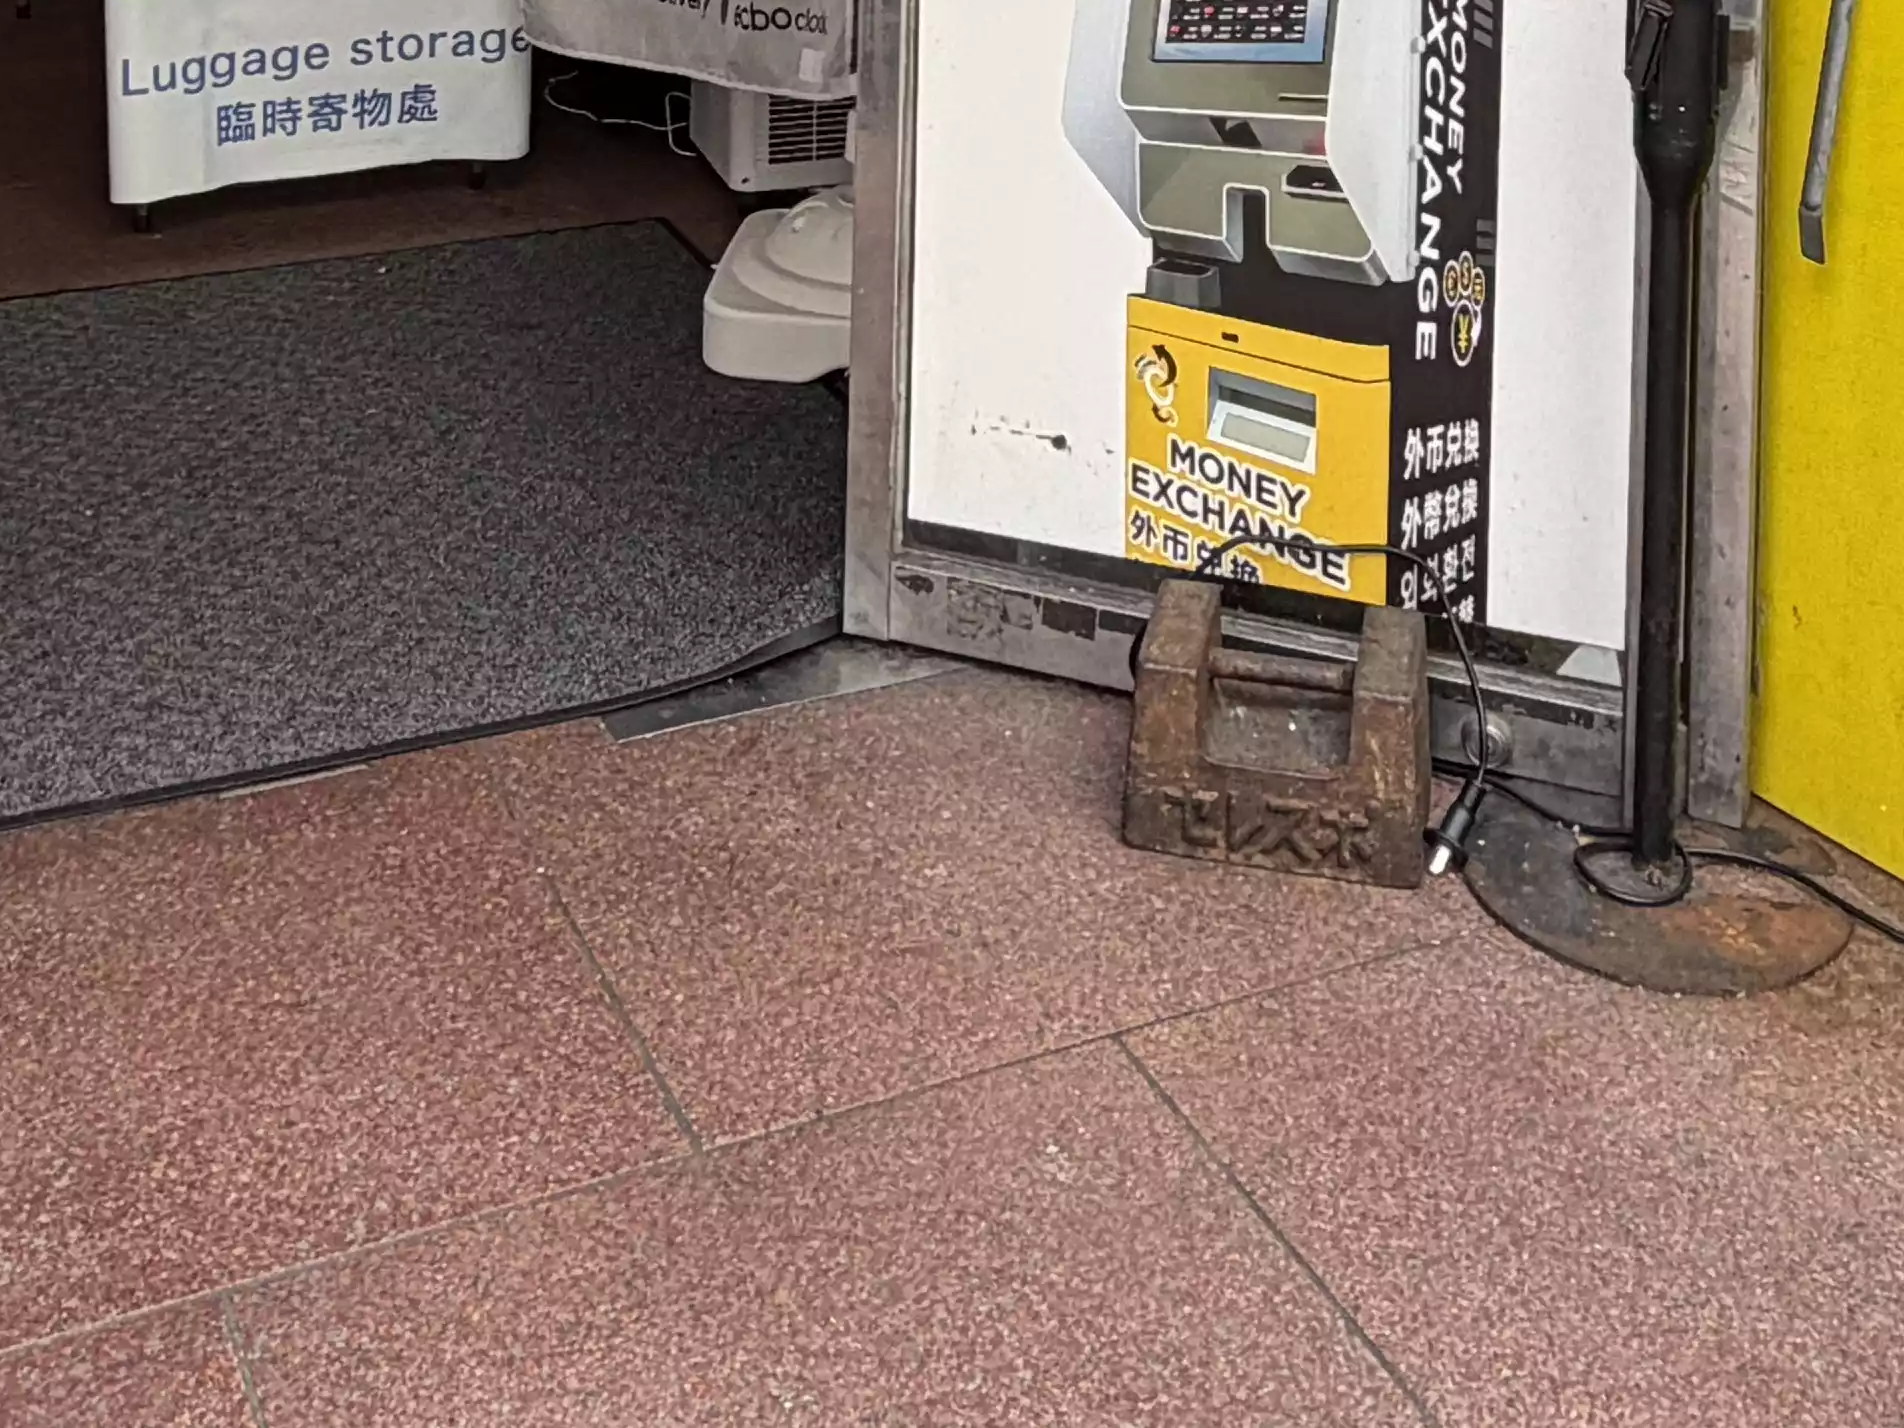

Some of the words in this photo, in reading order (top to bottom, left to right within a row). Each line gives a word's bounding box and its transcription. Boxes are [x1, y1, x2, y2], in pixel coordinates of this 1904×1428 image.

[121, 43, 331, 97] Luggage
[349, 25, 531, 68] storage
[215, 83, 439, 147] 臨時寄物處
[1170, 437, 1307, 518] MONEY
[1403, 417, 1480, 481] 外币兑换
[1131, 462, 1347, 586] EXCHANGE
